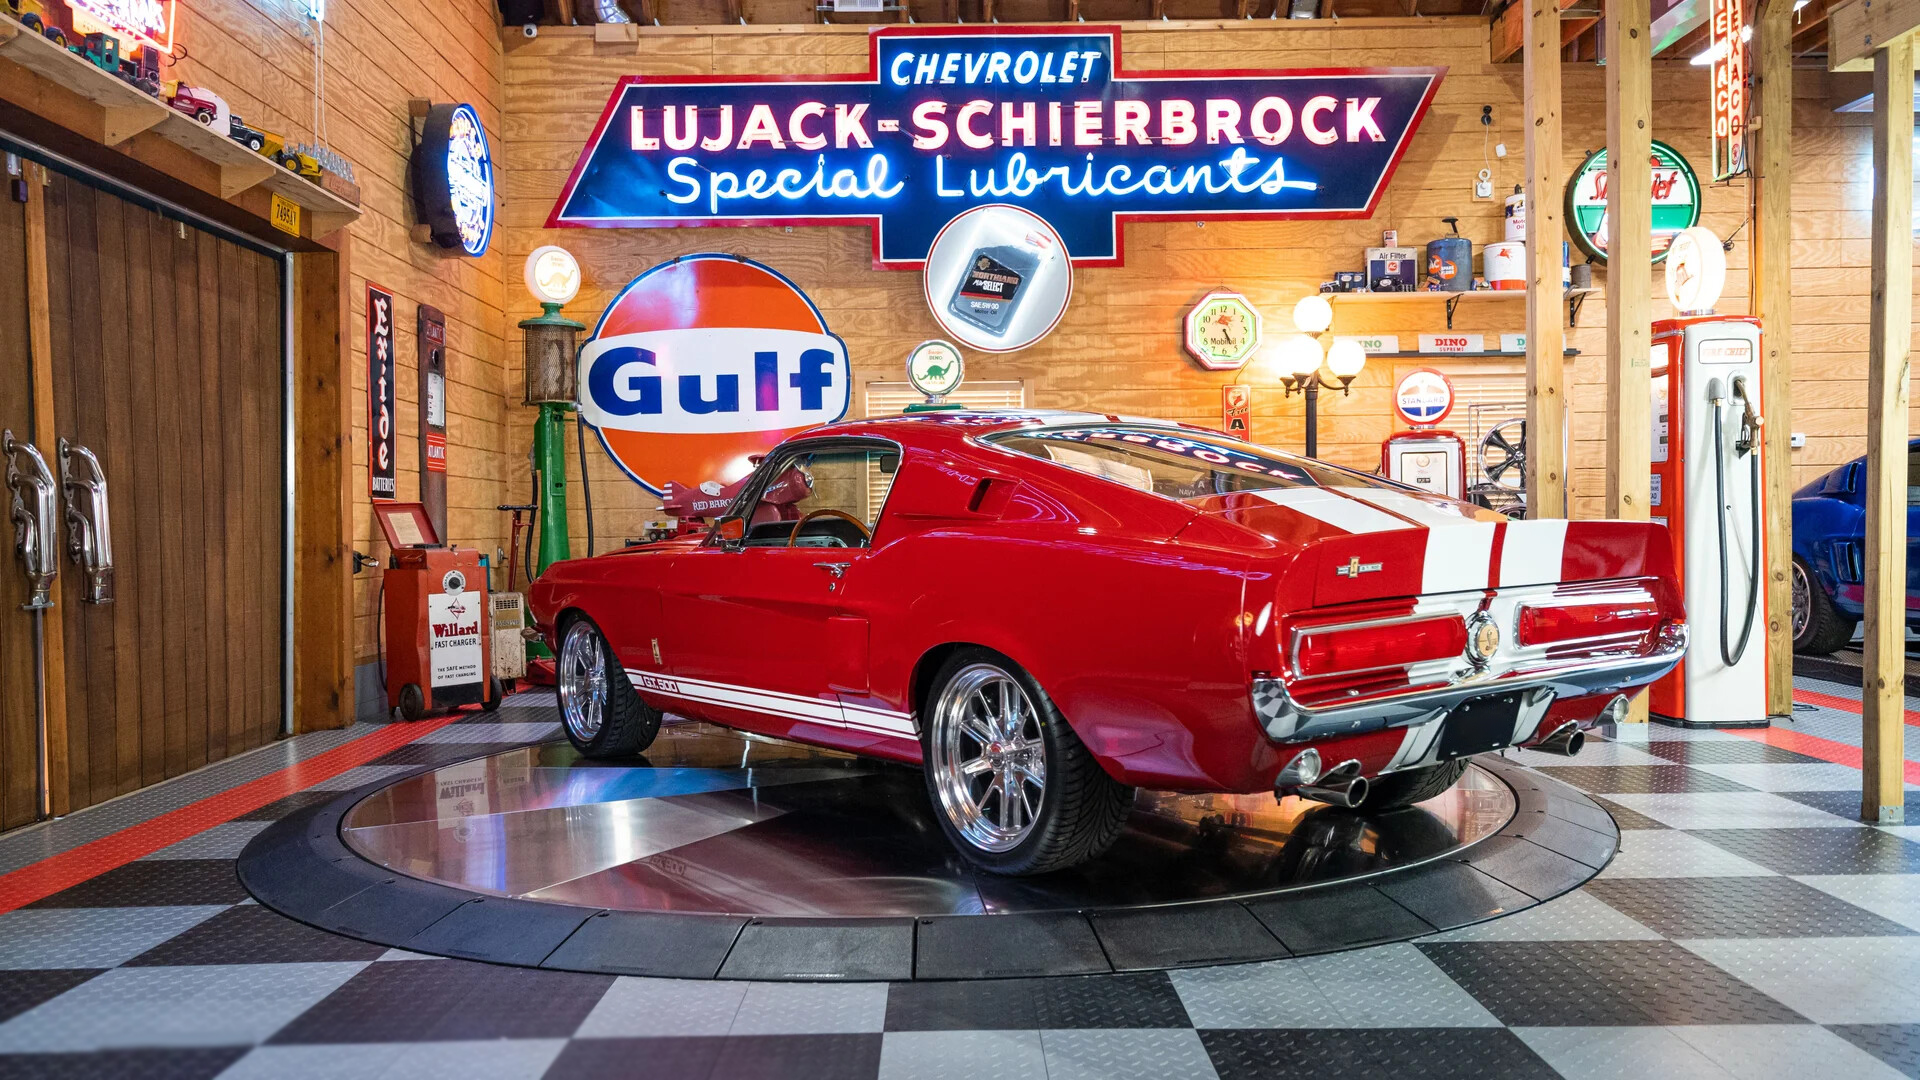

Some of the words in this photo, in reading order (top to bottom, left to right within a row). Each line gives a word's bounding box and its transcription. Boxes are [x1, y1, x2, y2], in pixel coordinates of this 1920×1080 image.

[891, 50, 1101, 86] CHEVROLET
[630, 96, 1387, 151] LUJACK-SCHIERBROCK
[666, 153, 904, 214] Special
[936, 147, 1318, 198] Lubricants
[1379, 252, 1388, 260] Air
[1390, 252, 1407, 260] Filter
[1211, 308, 1217, 316] 11
[1220, 305, 1228, 313] 12
[1203, 315, 1211, 323] 10
[1243, 326, 1248, 334] 3
[1240, 337, 1245, 345] 4
[1435, 338, 1468, 347] DINO
[588, 346, 835, 416] Gulf
[428, 445, 445, 459] ATLANTIC
[372, 477, 394, 492] BATTERIES
[692, 501, 709, 511] RED
[432, 620, 478, 638] Willard
[435, 641, 448, 649] FAST
[449, 638, 477, 648] CHARGER
